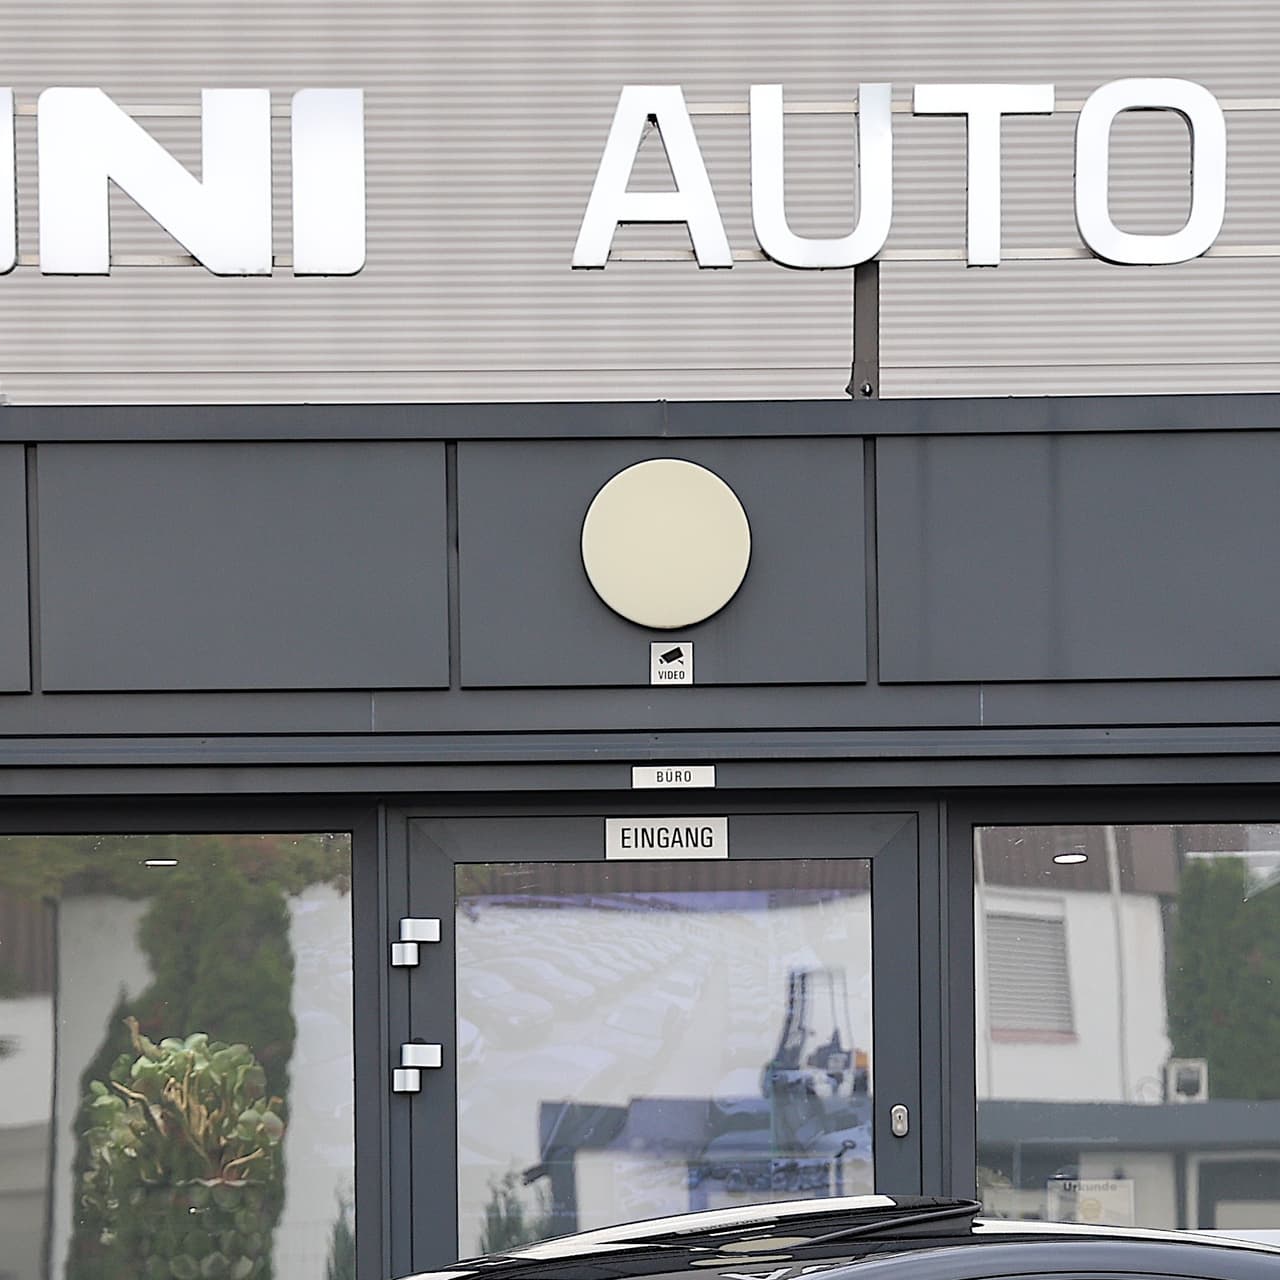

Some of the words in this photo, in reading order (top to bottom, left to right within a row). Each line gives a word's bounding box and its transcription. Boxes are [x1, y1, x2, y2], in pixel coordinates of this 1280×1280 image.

[572, 77, 1226, 270] AUTO
[658, 670, 685, 680] VIDEO
[656, 768, 692, 783] BÜRO
[621, 827, 714, 849] EINGANG
